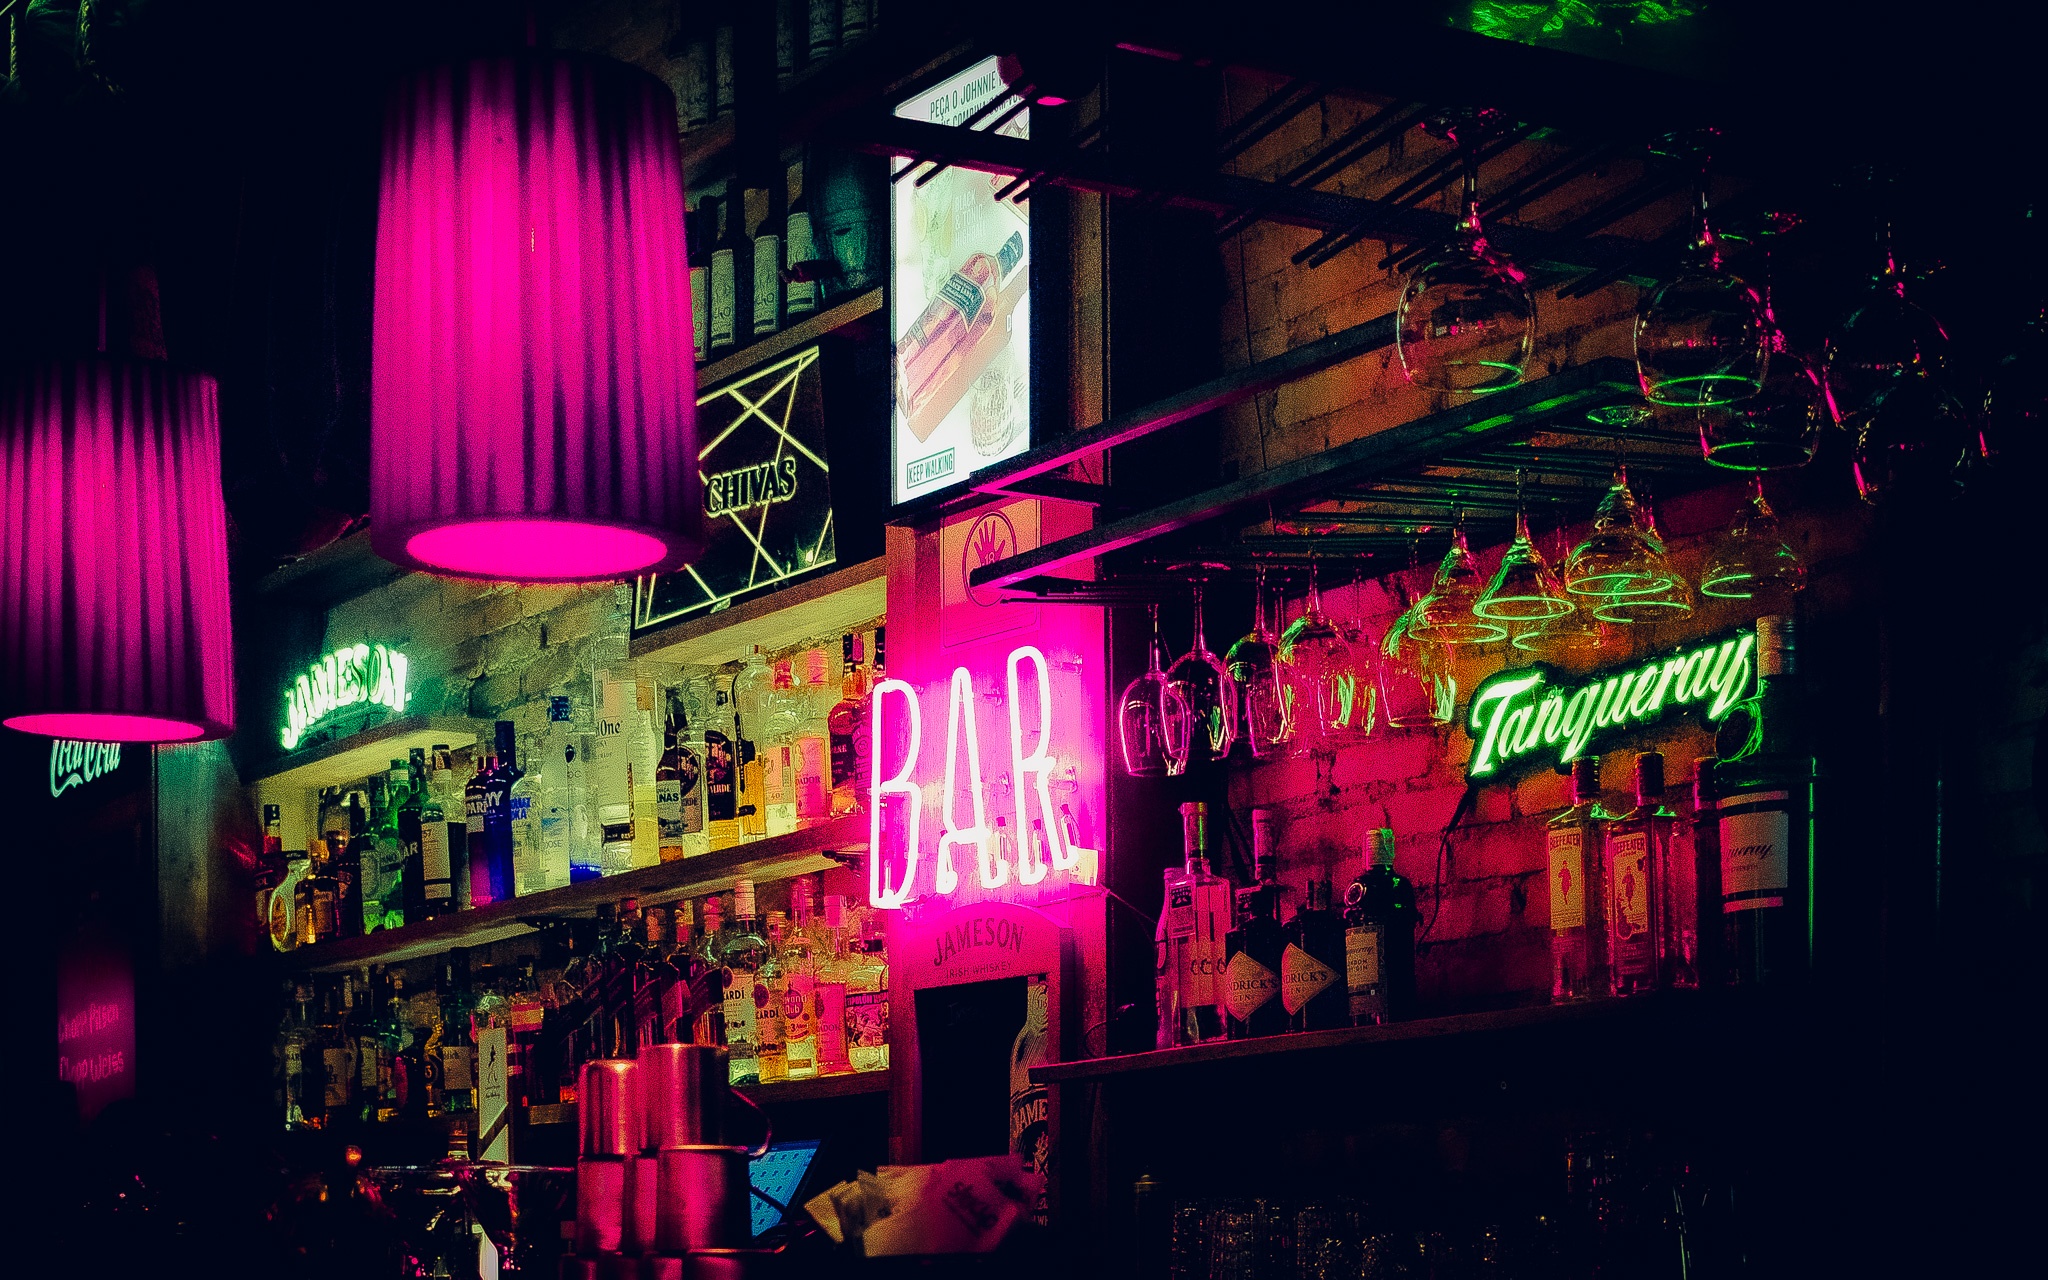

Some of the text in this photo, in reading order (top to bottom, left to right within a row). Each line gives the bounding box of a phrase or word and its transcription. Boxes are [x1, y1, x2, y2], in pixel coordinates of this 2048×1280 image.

[929, 94, 950, 121] PEÇA
[952, 90, 958, 109] O
[960, 70, 996, 105] JOHNNIE
[705, 458, 797, 517] CHIVAS
[908, 455, 953, 484] KEEP WALKING
[283, 643, 410, 750] JAMESON
[1471, 635, 1754, 777] Tanqueray
[870, 646, 1079, 910] BAR
[933, 917, 1025, 967] JAMESON
[945, 961, 1012, 979] IRISH WHISKEY
[1231, 978, 1279, 991] DRICK'S
[1283, 970, 1329, 984] DRICK'S
[1012, 1098, 1049, 1139] JAME
